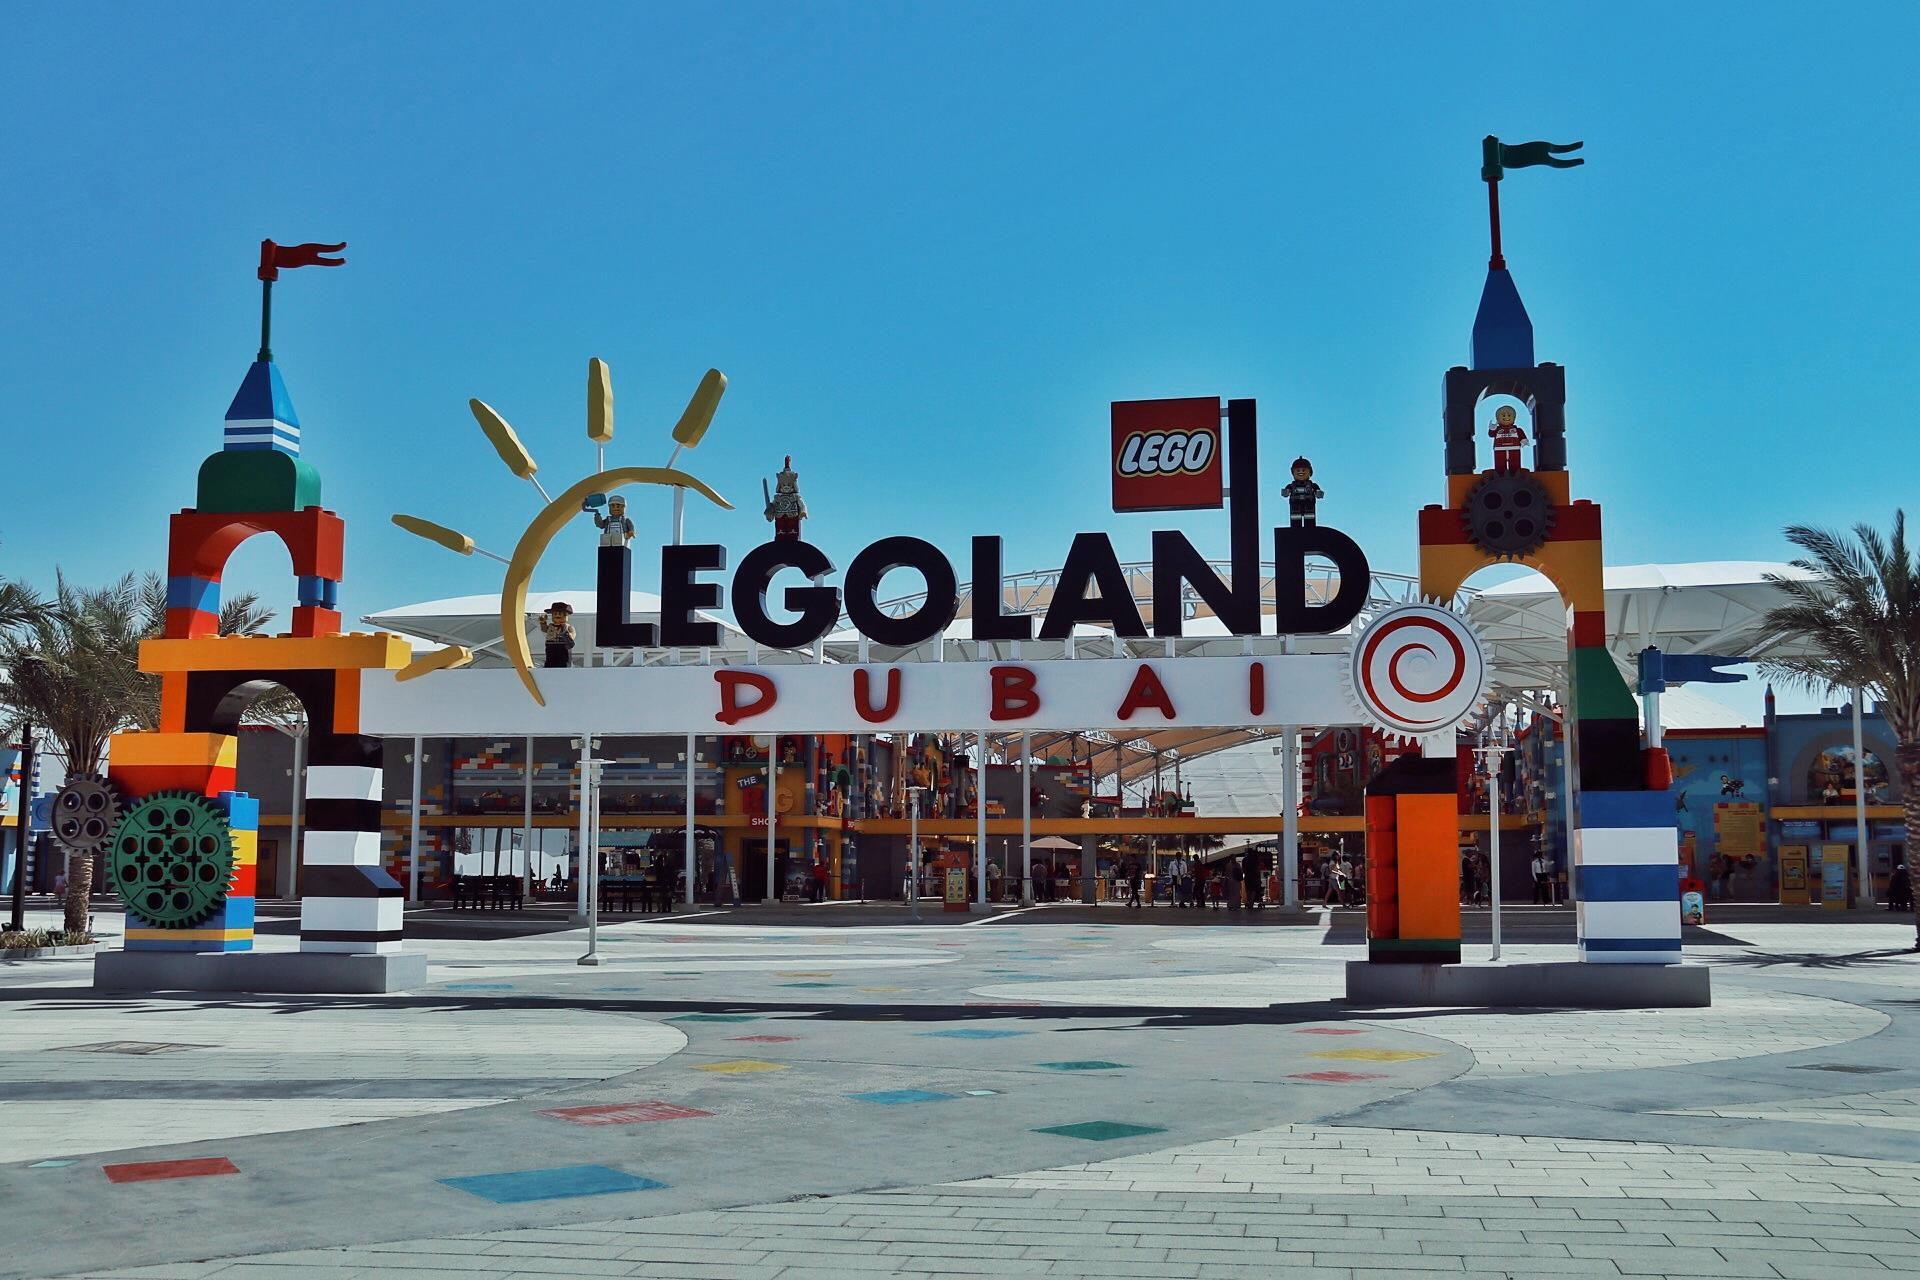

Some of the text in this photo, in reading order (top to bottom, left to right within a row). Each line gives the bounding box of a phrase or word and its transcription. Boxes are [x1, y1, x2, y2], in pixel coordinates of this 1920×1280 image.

[1120, 432, 1212, 474] LEGO
[596, 399, 1370, 648] LEGOLAND
[715, 663, 1264, 724] DUBAI
[737, 776, 757, 787] THE
